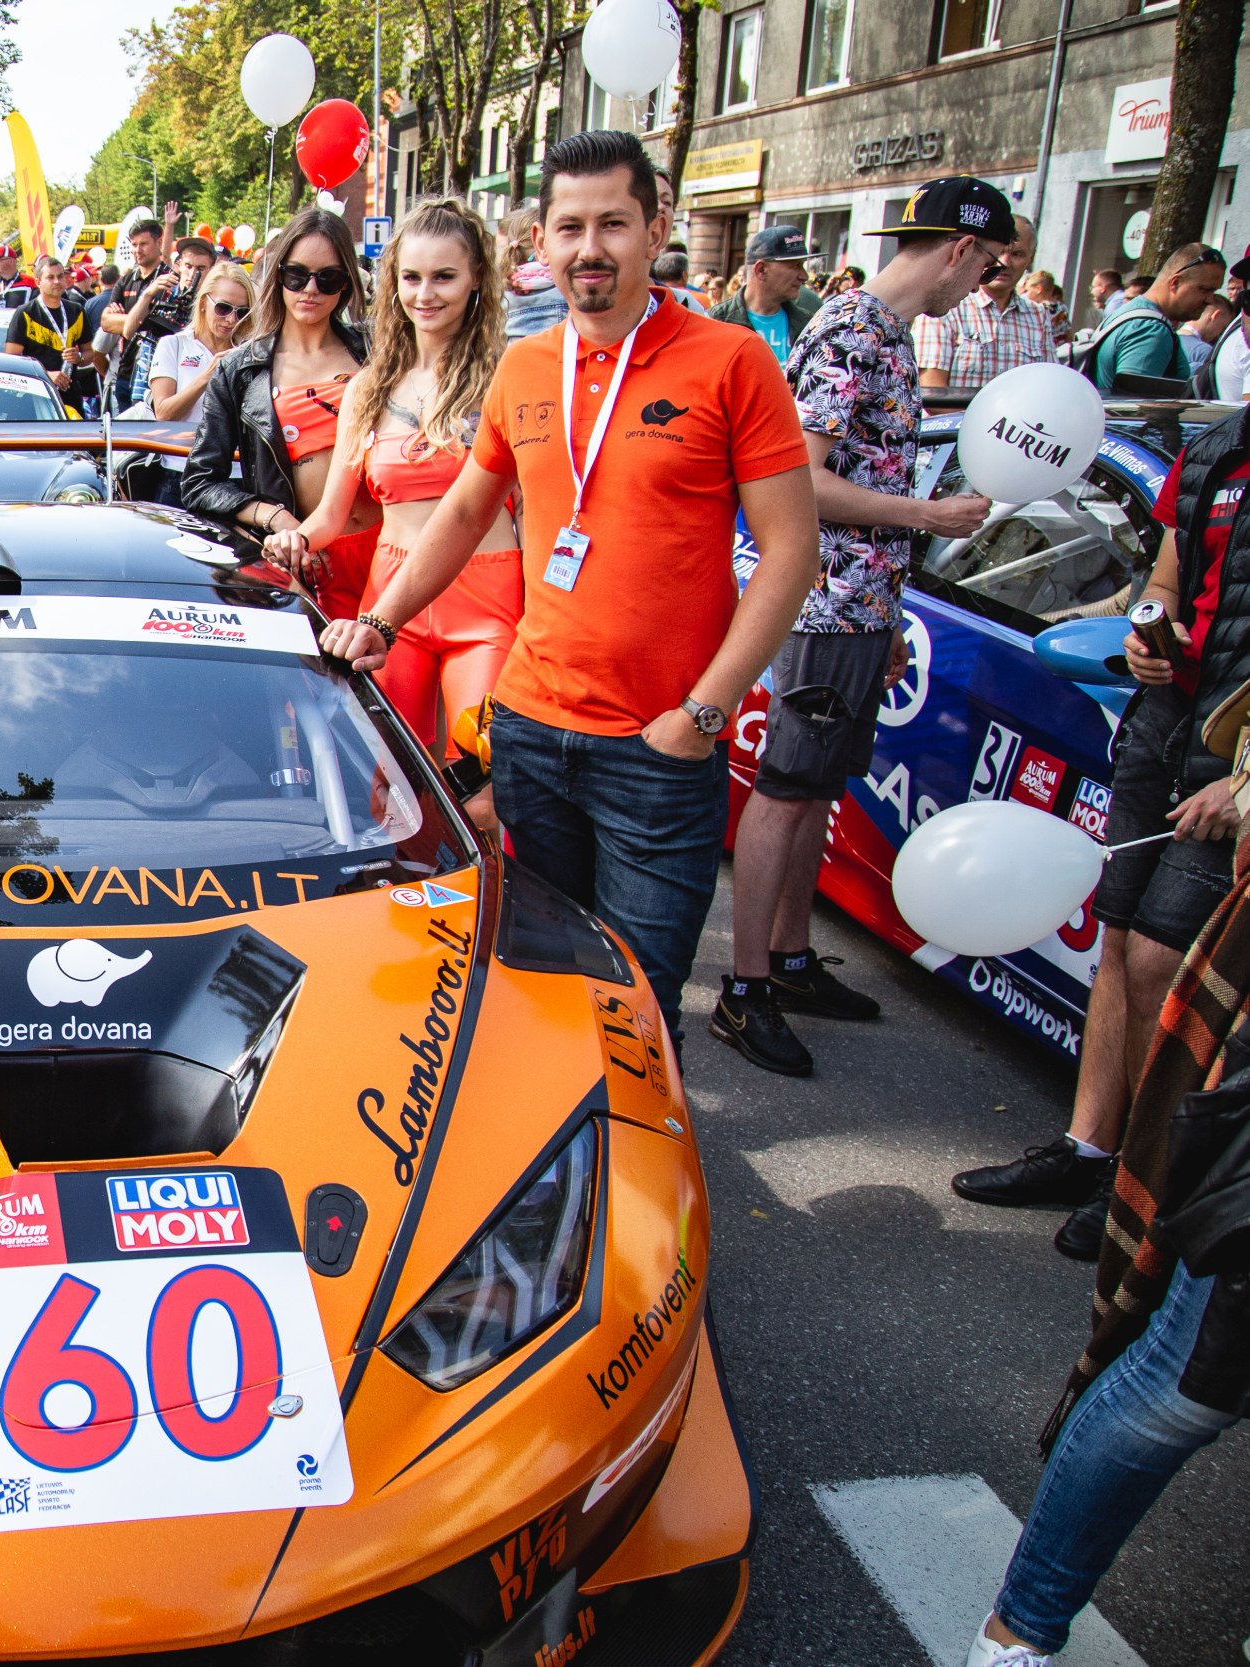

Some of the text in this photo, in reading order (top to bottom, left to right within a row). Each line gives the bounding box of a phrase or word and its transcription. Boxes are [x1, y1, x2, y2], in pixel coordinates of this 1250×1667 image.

[852, 130, 942, 169] GRIZAS
[960, 204, 991, 217] ORIGINAL
[625, 429, 684, 443] gera dovana
[987, 416, 1072, 468] AURUM
[148, 608, 243, 625] AURUM
[1025, 760, 1057, 785] AURUM
[61, 1016, 152, 1041] dovana
[992, 970, 1081, 1056] dipwork
[594, 988, 647, 1080] UVS
[357, 918, 472, 1187] Lambooo.lt
[114, 1176, 233, 1211] LIQUI
[120, 1210, 241, 1247] MOLY
